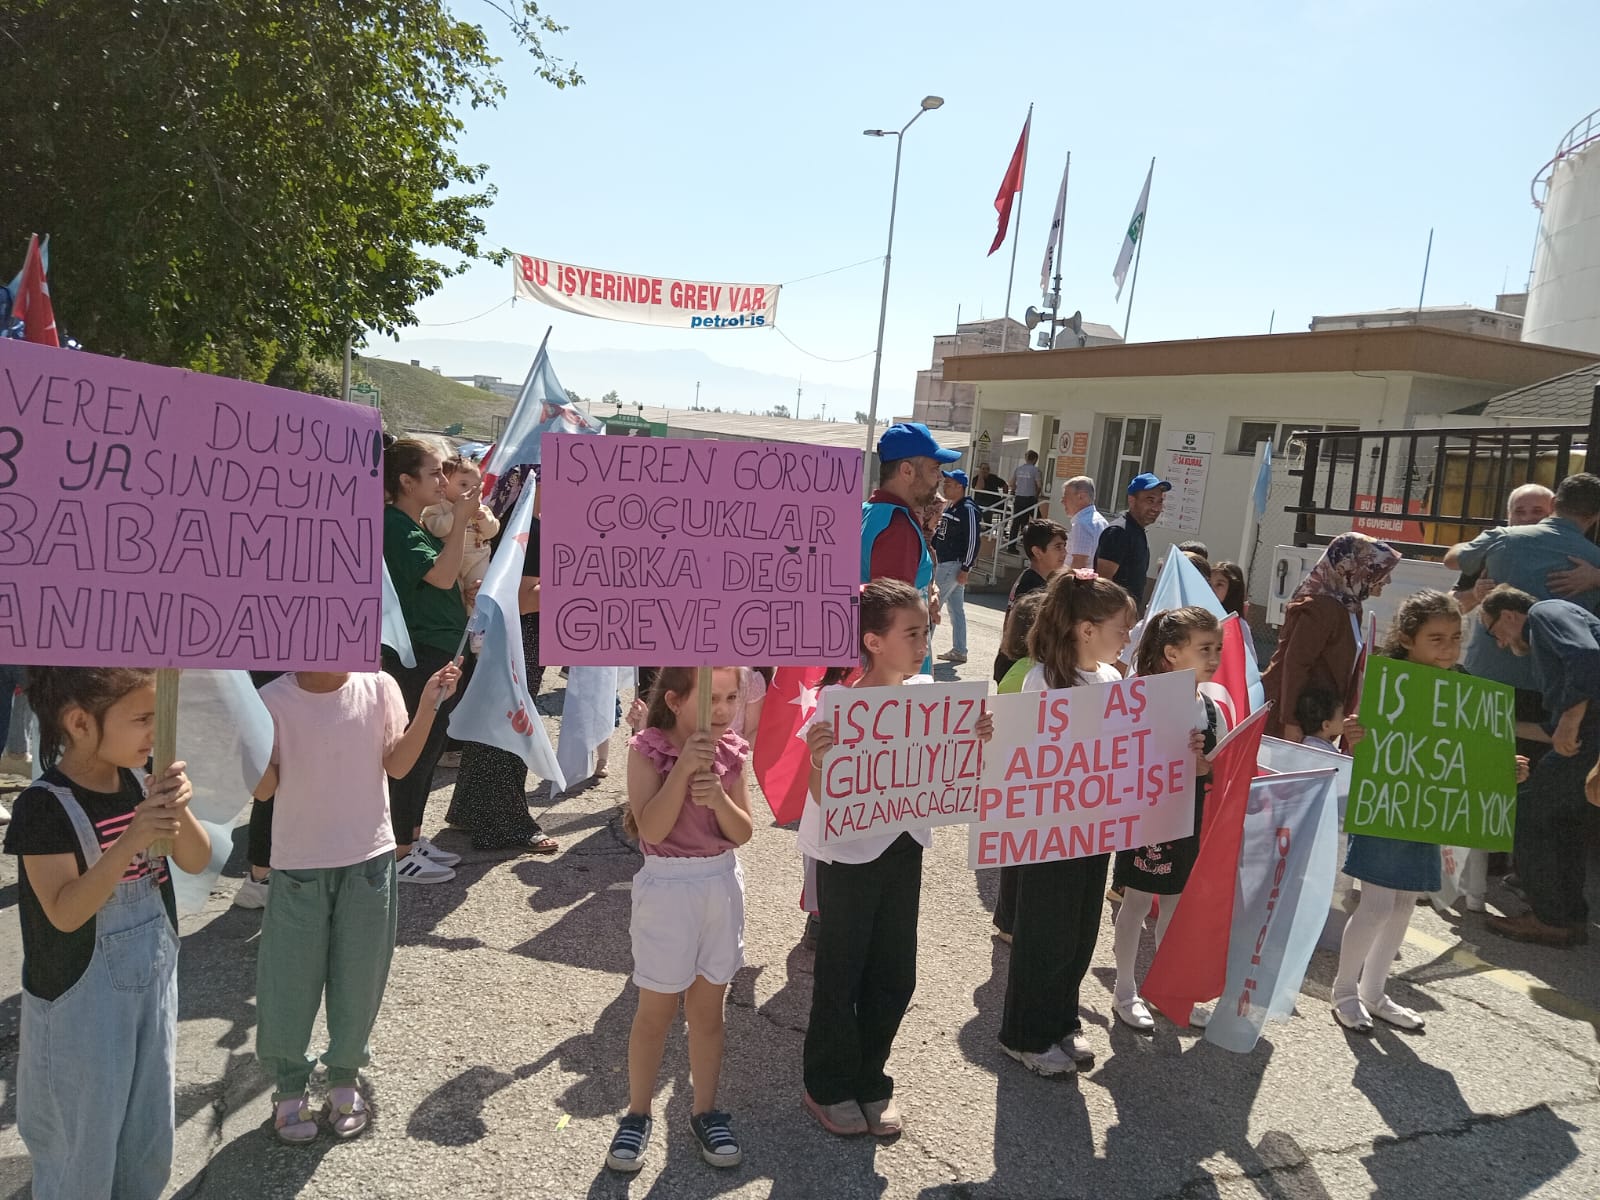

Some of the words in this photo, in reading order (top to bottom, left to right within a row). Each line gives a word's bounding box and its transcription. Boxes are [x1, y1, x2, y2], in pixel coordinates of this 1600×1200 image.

[520, 255, 549, 287] BU
[557, 262, 663, 305] İŞYERİNDE
[669, 281, 722, 312] GREV
[729, 287, 767, 313] VAR.
[205, 401, 382, 478] DUYSUN!
[554, 437, 718, 487] İŞVEREN
[733, 447, 860, 495] GÖRSÜN
[58, 439, 358, 516] YAŞINDAYIM
[0, 491, 374, 585] BABAMIN
[586, 492, 836, 546] ÇOÇUKLAR
[551, 543, 703, 590] PARKA
[721, 545, 852, 596] DEĞİL
[555, 597, 721, 653] GREVE
[731, 595, 861, 660] GELDİ
[1036, 690, 1070, 742] İŞ
[1103, 679, 1148, 723] AŞ
[1376, 666, 1410, 725] İŞ
[1431, 678, 1516, 745] EKMEK
[825, 739, 984, 799] GÜÇLÜYÜZ!
[1003, 728, 1152, 782] ADALET
[824, 782, 980, 842] KAZANACAĞIZ!
[976, 813, 1141, 865] EMANET
[1478, 790, 1517, 838] YOK
